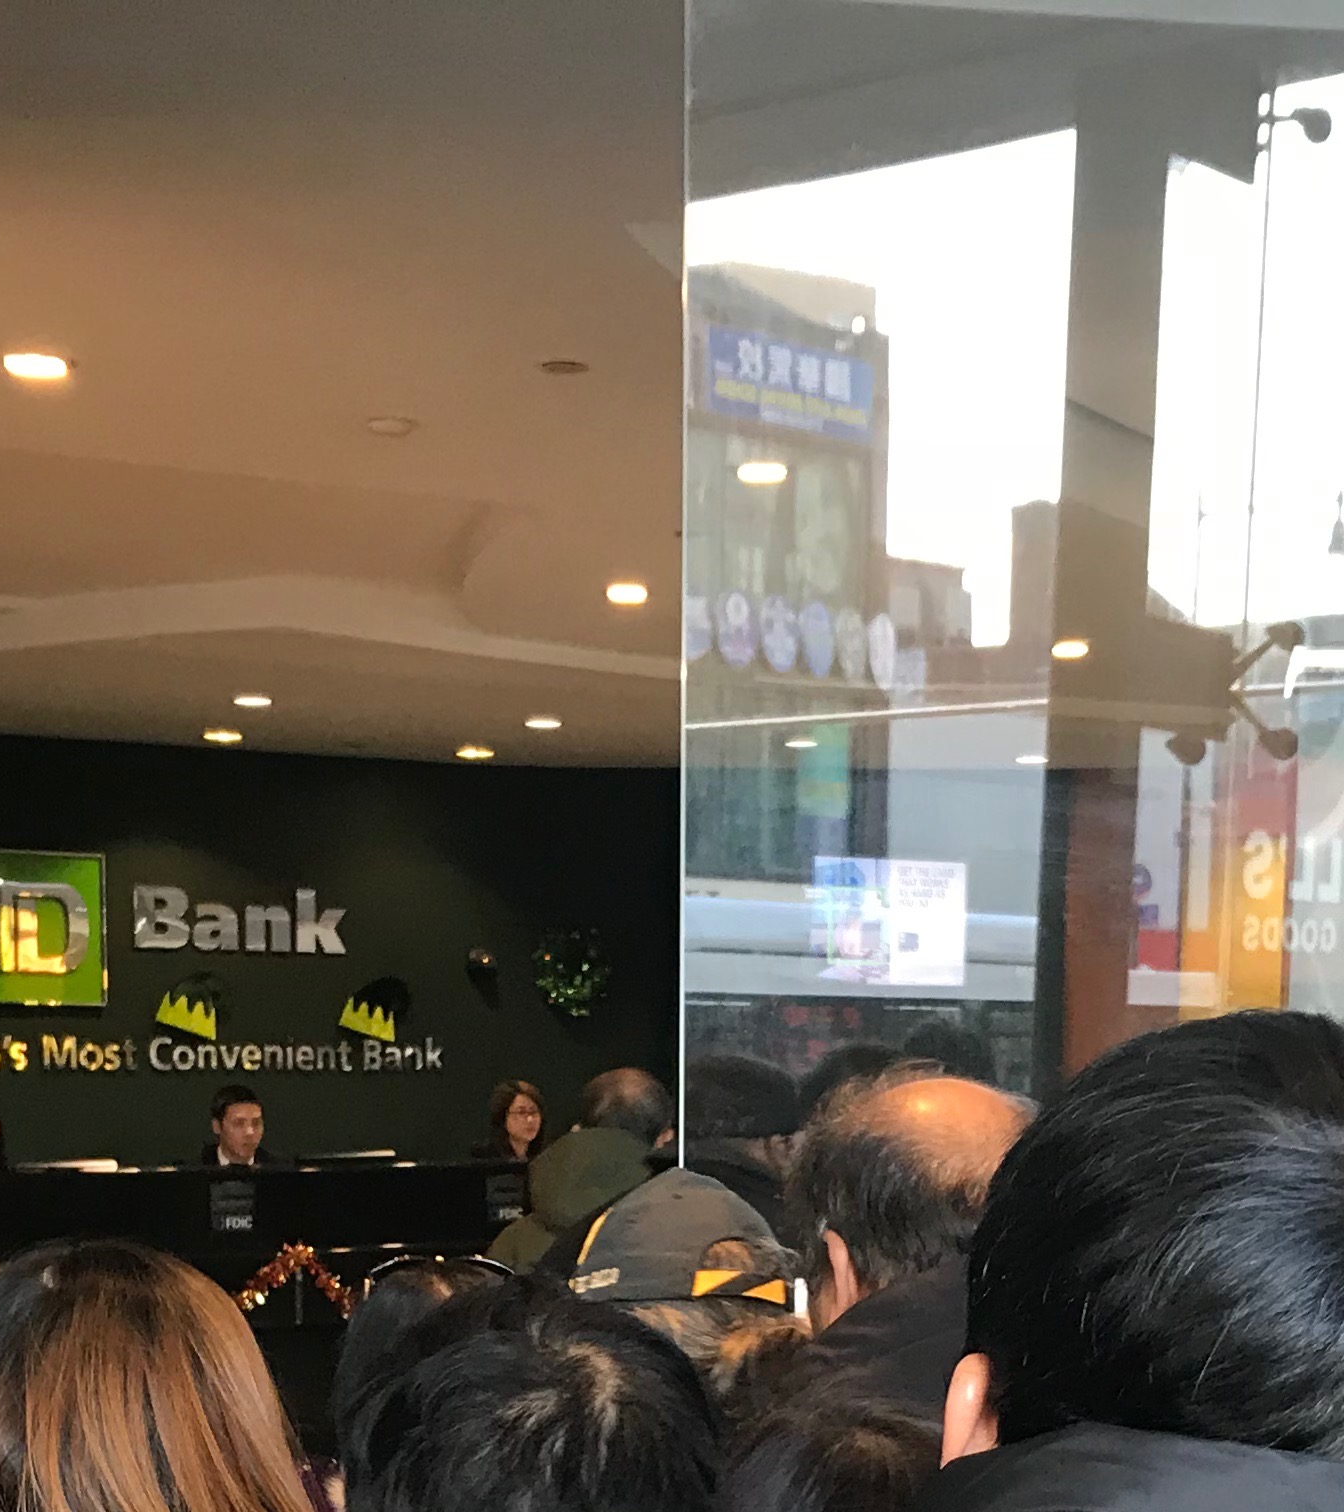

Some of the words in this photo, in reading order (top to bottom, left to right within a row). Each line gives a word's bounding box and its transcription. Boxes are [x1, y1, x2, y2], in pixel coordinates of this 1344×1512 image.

[132, 884, 348, 956] Bank
[41, 1034, 140, 1073] Most
[148, 1036, 355, 1074] Convenient
[362, 1036, 445, 1074] Bank
[225, 1214, 253, 1230] FDIC
